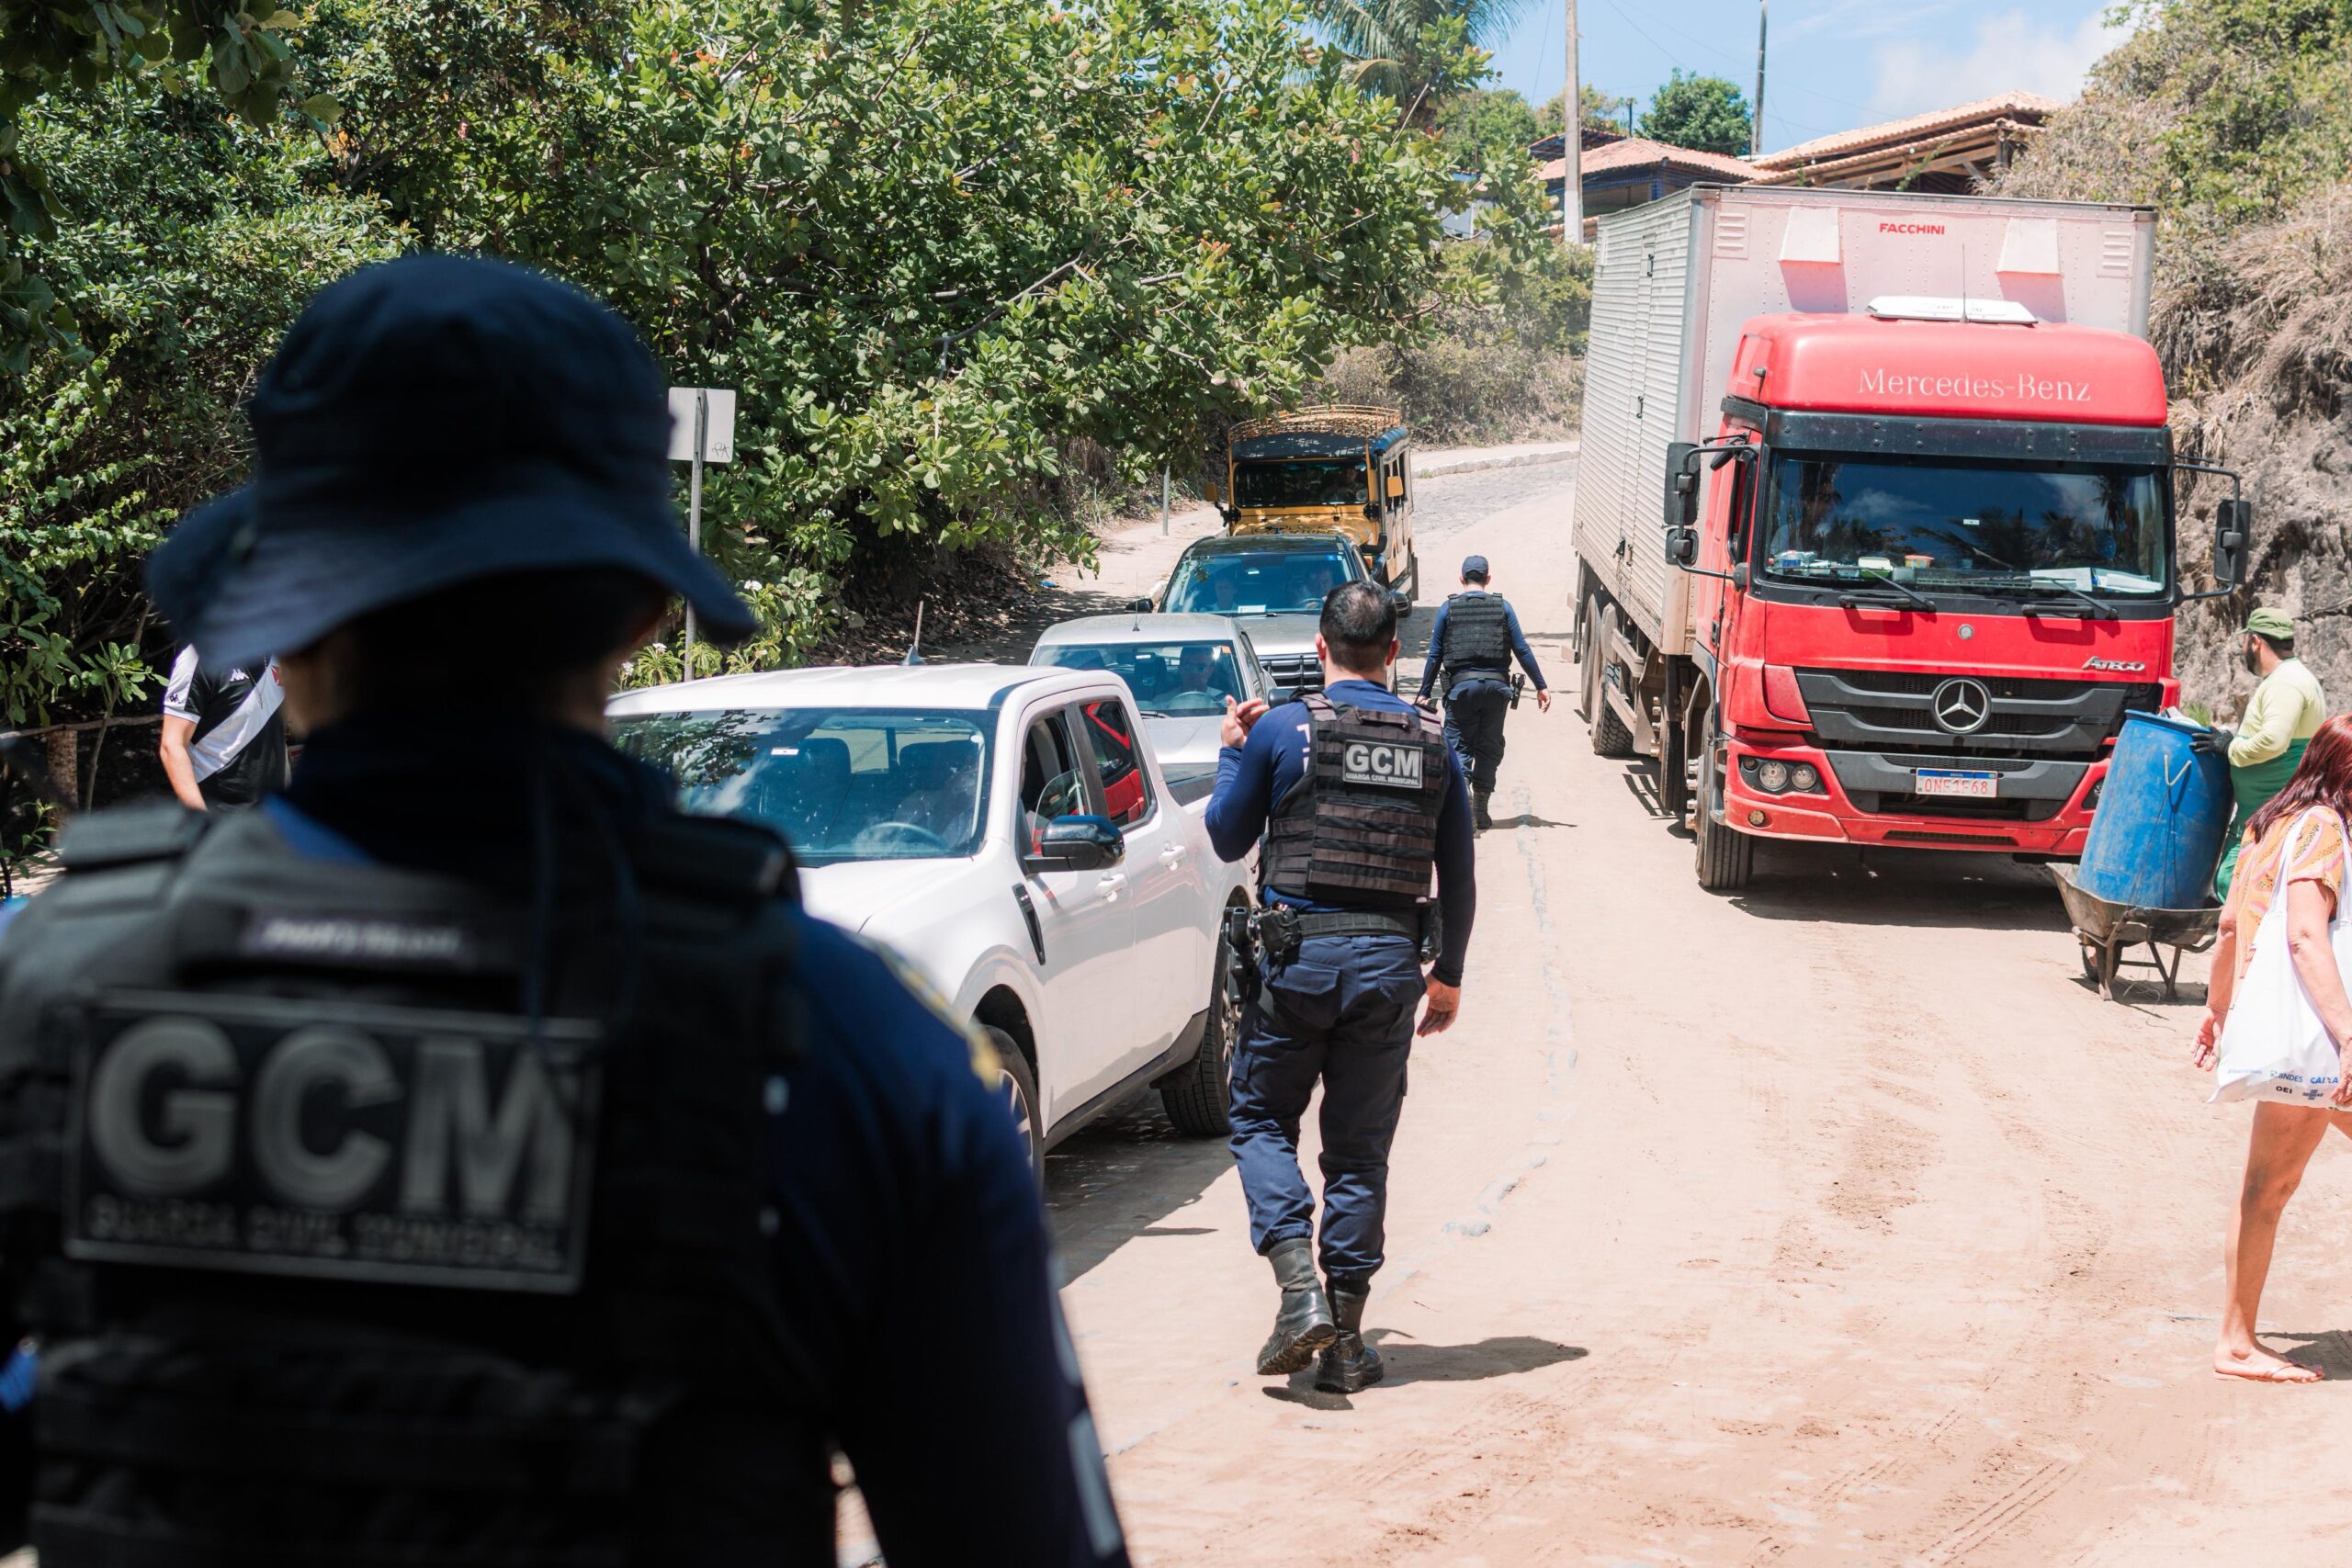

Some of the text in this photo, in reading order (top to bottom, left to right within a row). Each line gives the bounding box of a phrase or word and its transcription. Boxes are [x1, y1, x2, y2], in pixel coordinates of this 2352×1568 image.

[1879, 222, 1945, 235] FACCHINI
[1858, 367, 2092, 402] Mercedes-Benz
[1346, 744, 1419, 777] GCM
[1387, 776, 1419, 785] MUNICIPAL
[2310, 1076, 2338, 1084] CAIXA
[2276, 1086, 2293, 1094] OEI
[91, 1015, 574, 1219] GCM
